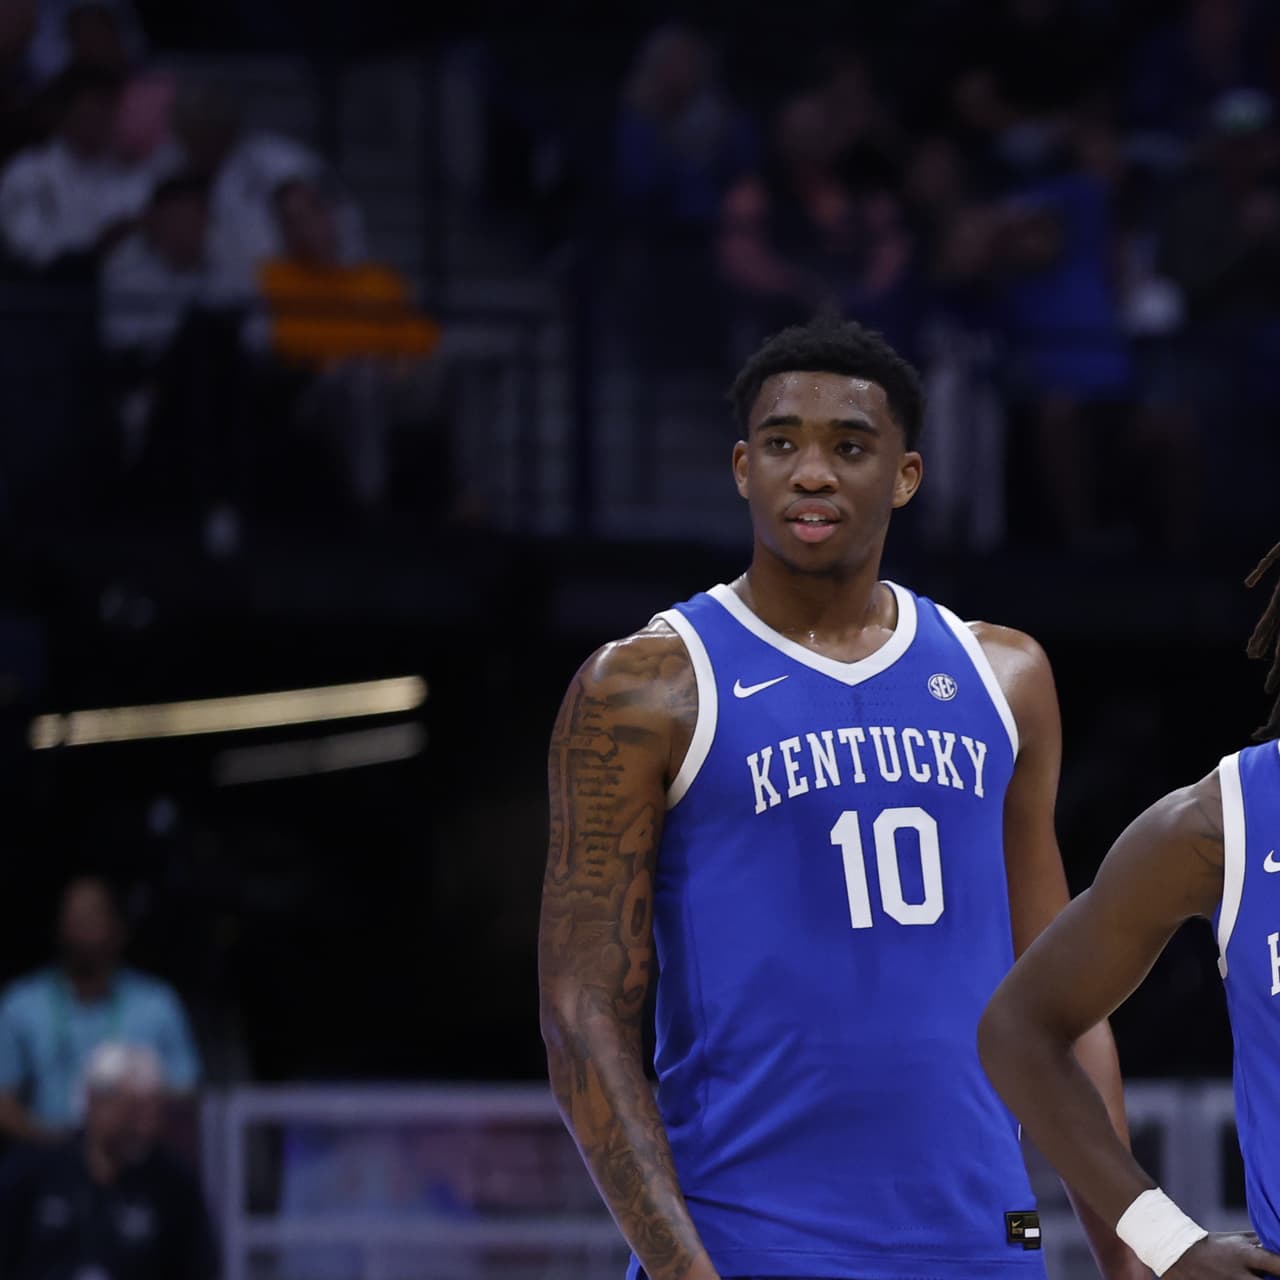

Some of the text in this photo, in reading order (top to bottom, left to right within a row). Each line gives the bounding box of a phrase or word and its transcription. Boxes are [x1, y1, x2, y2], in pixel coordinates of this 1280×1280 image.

[930, 677, 956, 699] SEC
[746, 726, 988, 815] KENTUCKY
[829, 805, 944, 929] 10
